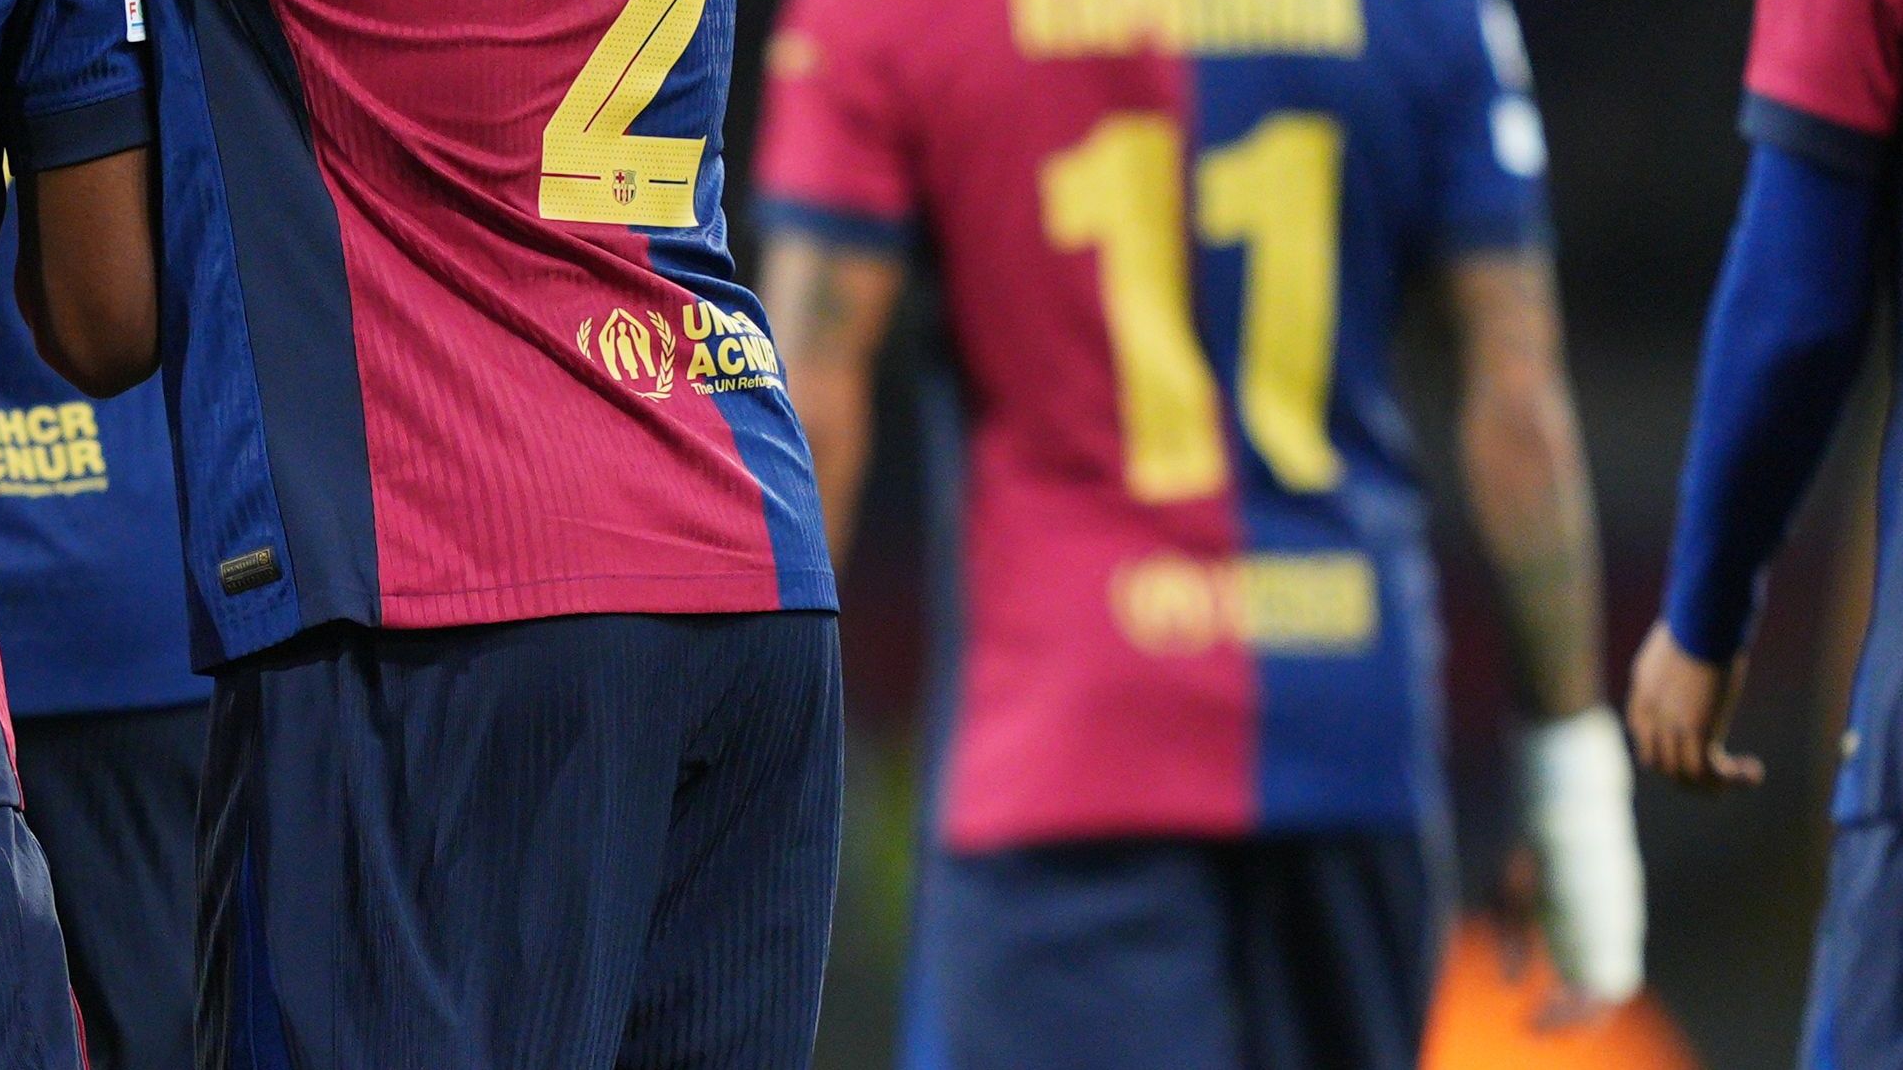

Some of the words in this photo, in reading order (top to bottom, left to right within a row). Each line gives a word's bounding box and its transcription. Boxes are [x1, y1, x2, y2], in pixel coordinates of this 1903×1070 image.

[691, 382, 714, 395] The
[715, 379, 736, 393] UN
[1039, 112, 1344, 503] 11
